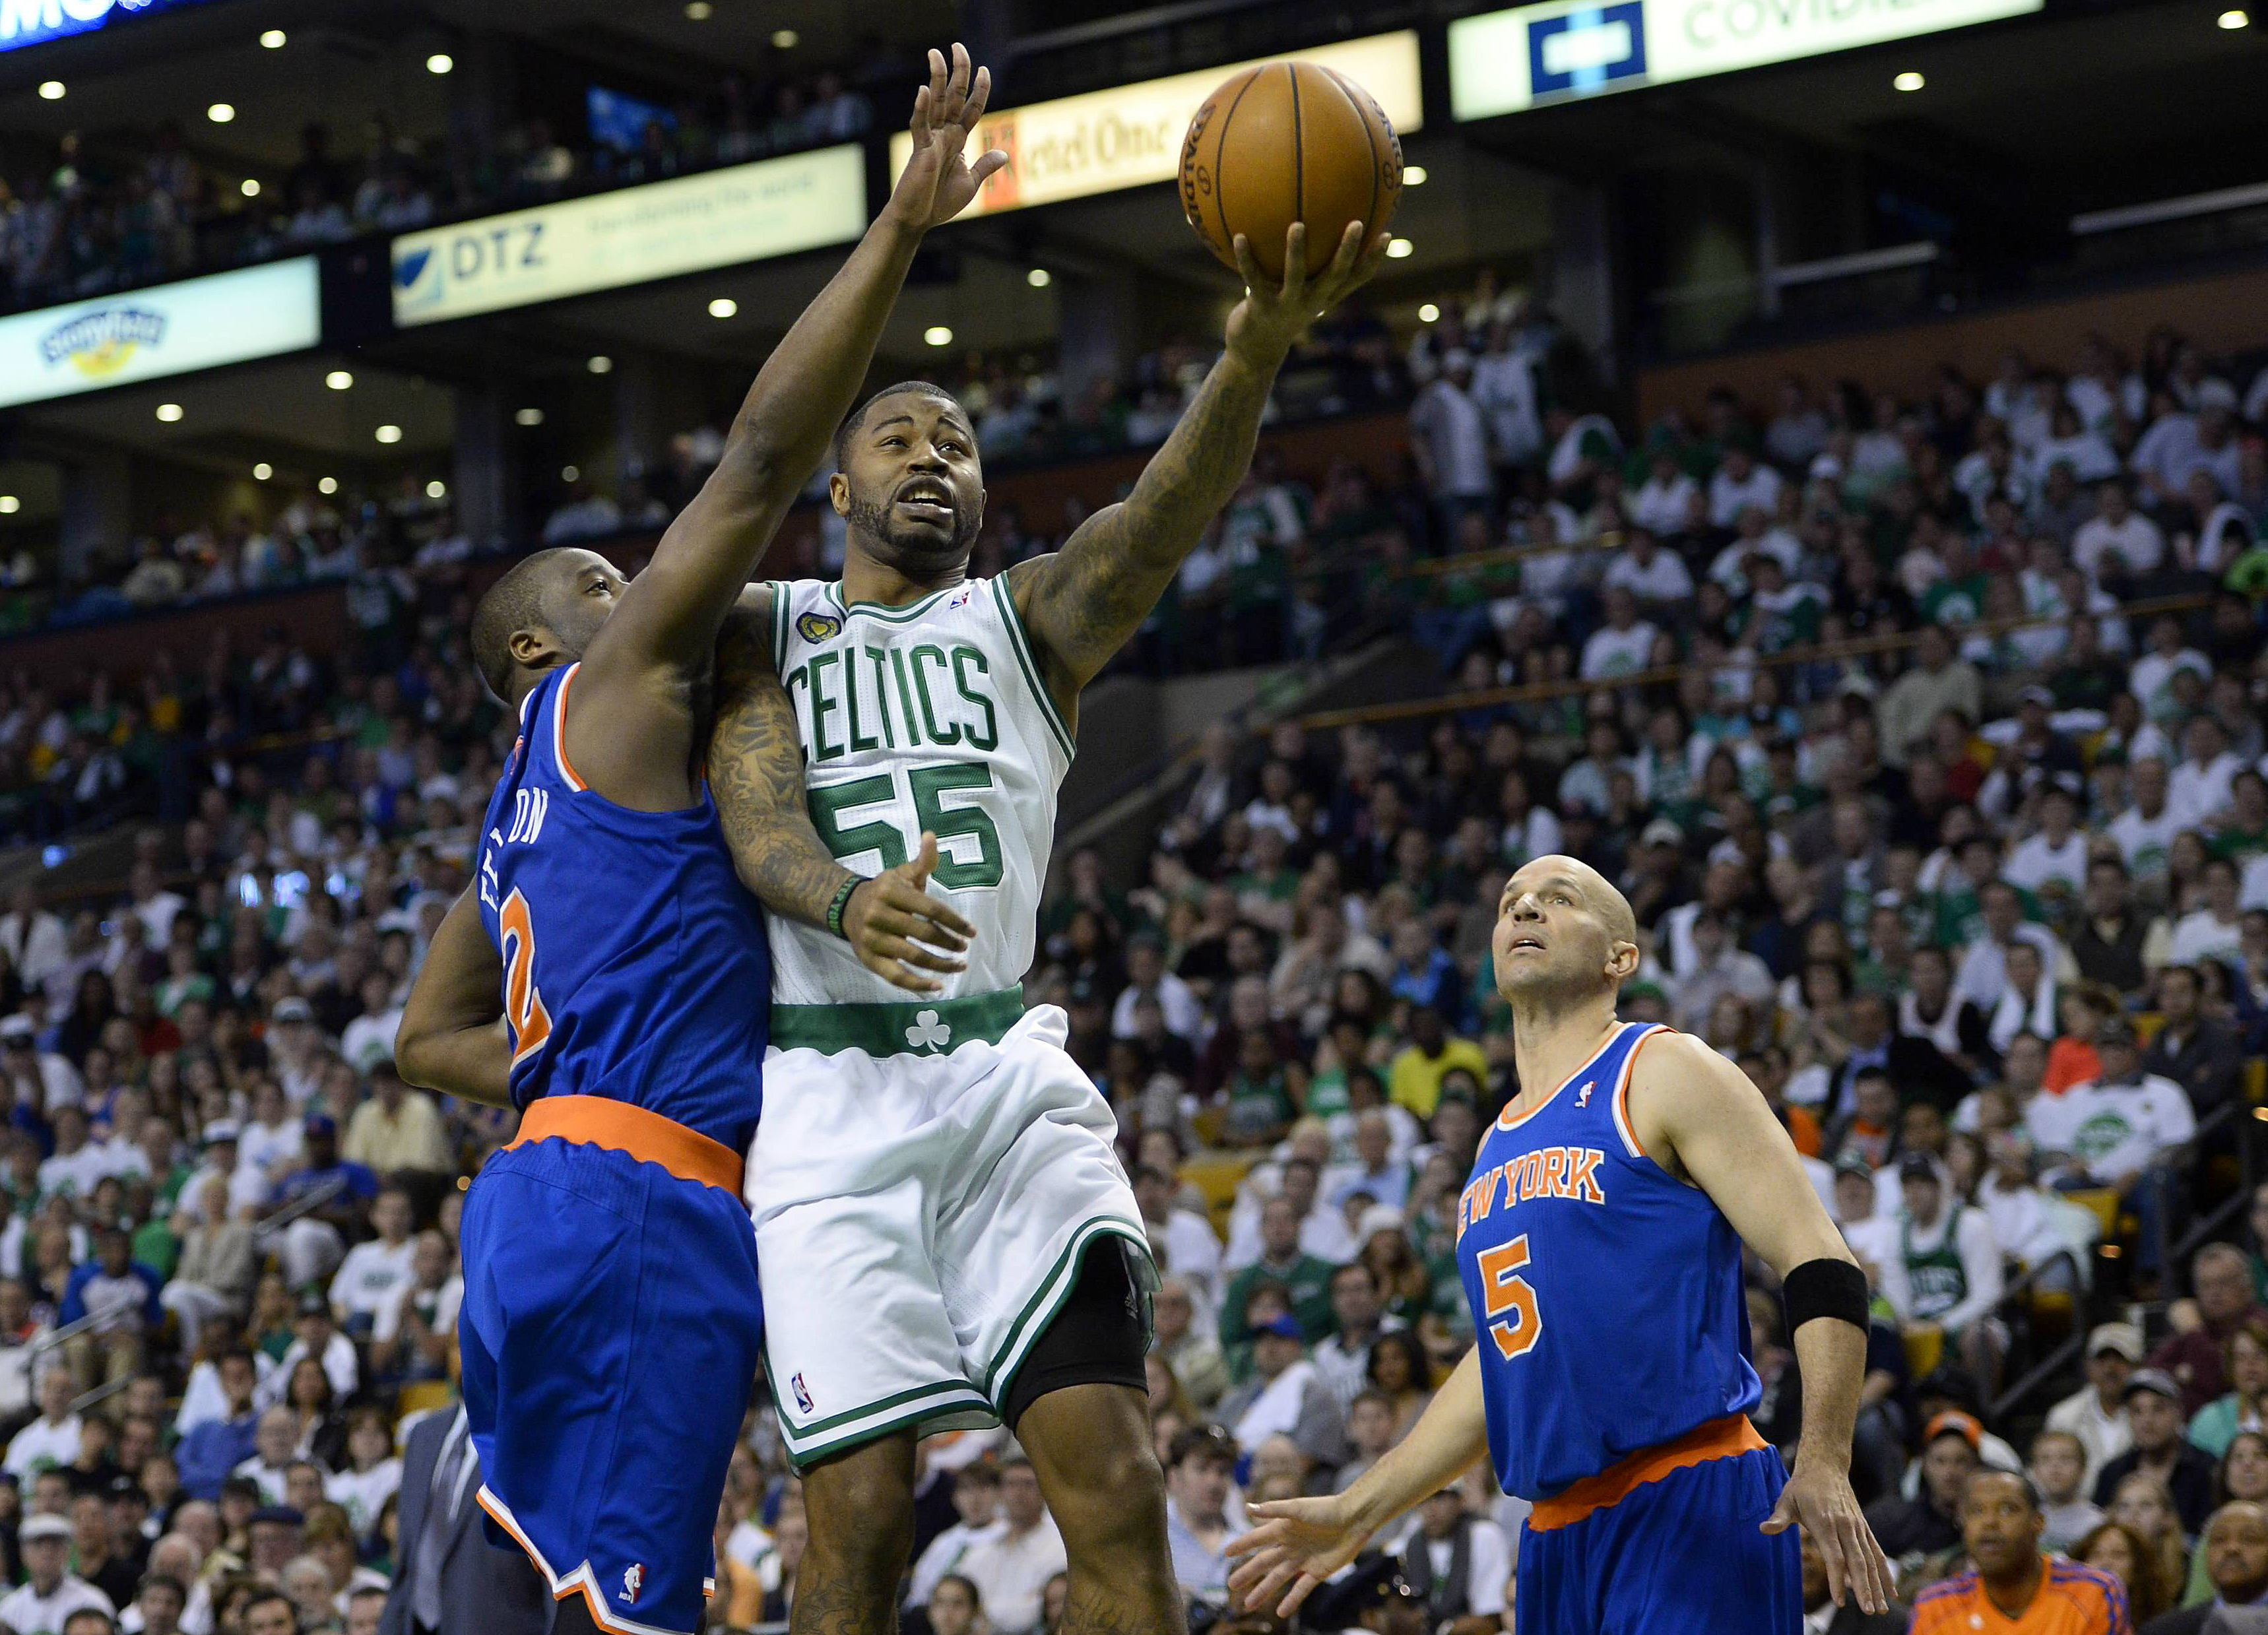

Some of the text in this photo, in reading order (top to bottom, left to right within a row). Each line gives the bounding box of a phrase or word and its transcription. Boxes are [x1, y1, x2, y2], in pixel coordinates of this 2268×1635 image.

[1682, 0, 1933, 49] COVID
[451, 222, 547, 282] DTZ
[806, 761, 1005, 891] 55
[500, 886, 553, 1073] 2
[1456, 1146, 1605, 1246] EW YORK
[1476, 1233, 1543, 1362] 5
